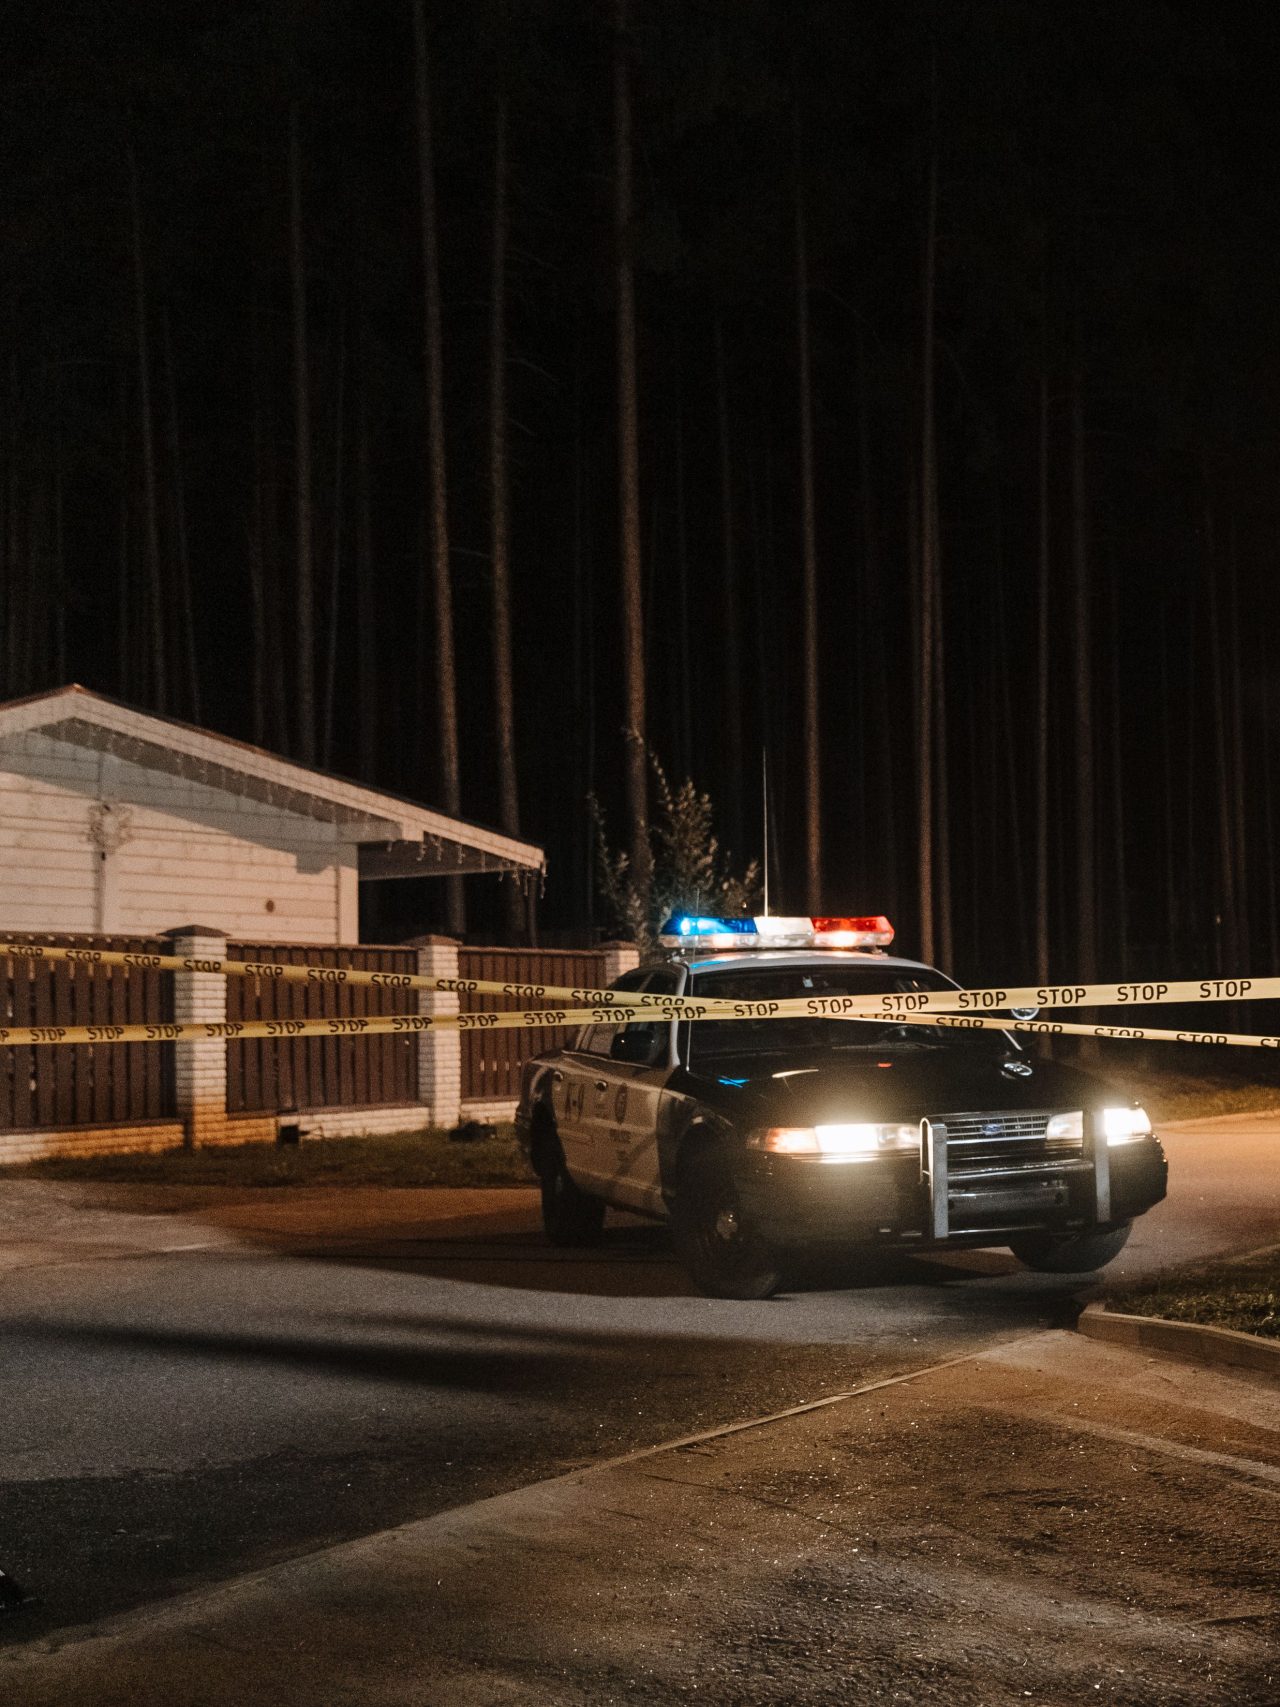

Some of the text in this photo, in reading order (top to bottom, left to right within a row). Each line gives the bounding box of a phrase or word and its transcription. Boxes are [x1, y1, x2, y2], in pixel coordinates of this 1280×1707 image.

[9, 946, 43, 958] STOP
[66, 951, 101, 963] STOP
[124, 955, 161, 968] STOP
[184, 960, 221, 973] STOP
[245, 964, 283, 978] STOP
[307, 970, 347, 984] STOP
[371, 975, 411, 989] STOP
[436, 980, 477, 993] STOP
[503, 985, 545, 998] STOP
[571, 990, 614, 1004] STOP
[30, 1029, 66, 1041] STOP
[87, 1027, 124, 1040] STOP
[146, 1025, 183, 1038] STOP
[206, 1023, 244, 1037] STOP
[266, 1021, 305, 1034] STOP
[328, 1019, 368, 1033] STOP
[392, 1016, 433, 1030] STOP
[458, 1014, 499, 1028] STOP
[524, 1011, 566, 1025] STOP
[592, 1008, 636, 1023] STOP
[663, 1006, 706, 1020] STOP
[734, 1002, 779, 1016] STOP
[807, 998, 853, 1015] STOP
[881, 994, 929, 1011] STOP
[958, 991, 1007, 1008] STOP
[1036, 988, 1087, 1005] STOP
[1117, 984, 1168, 1002] STOP
[1199, 980, 1252, 998] STOP
